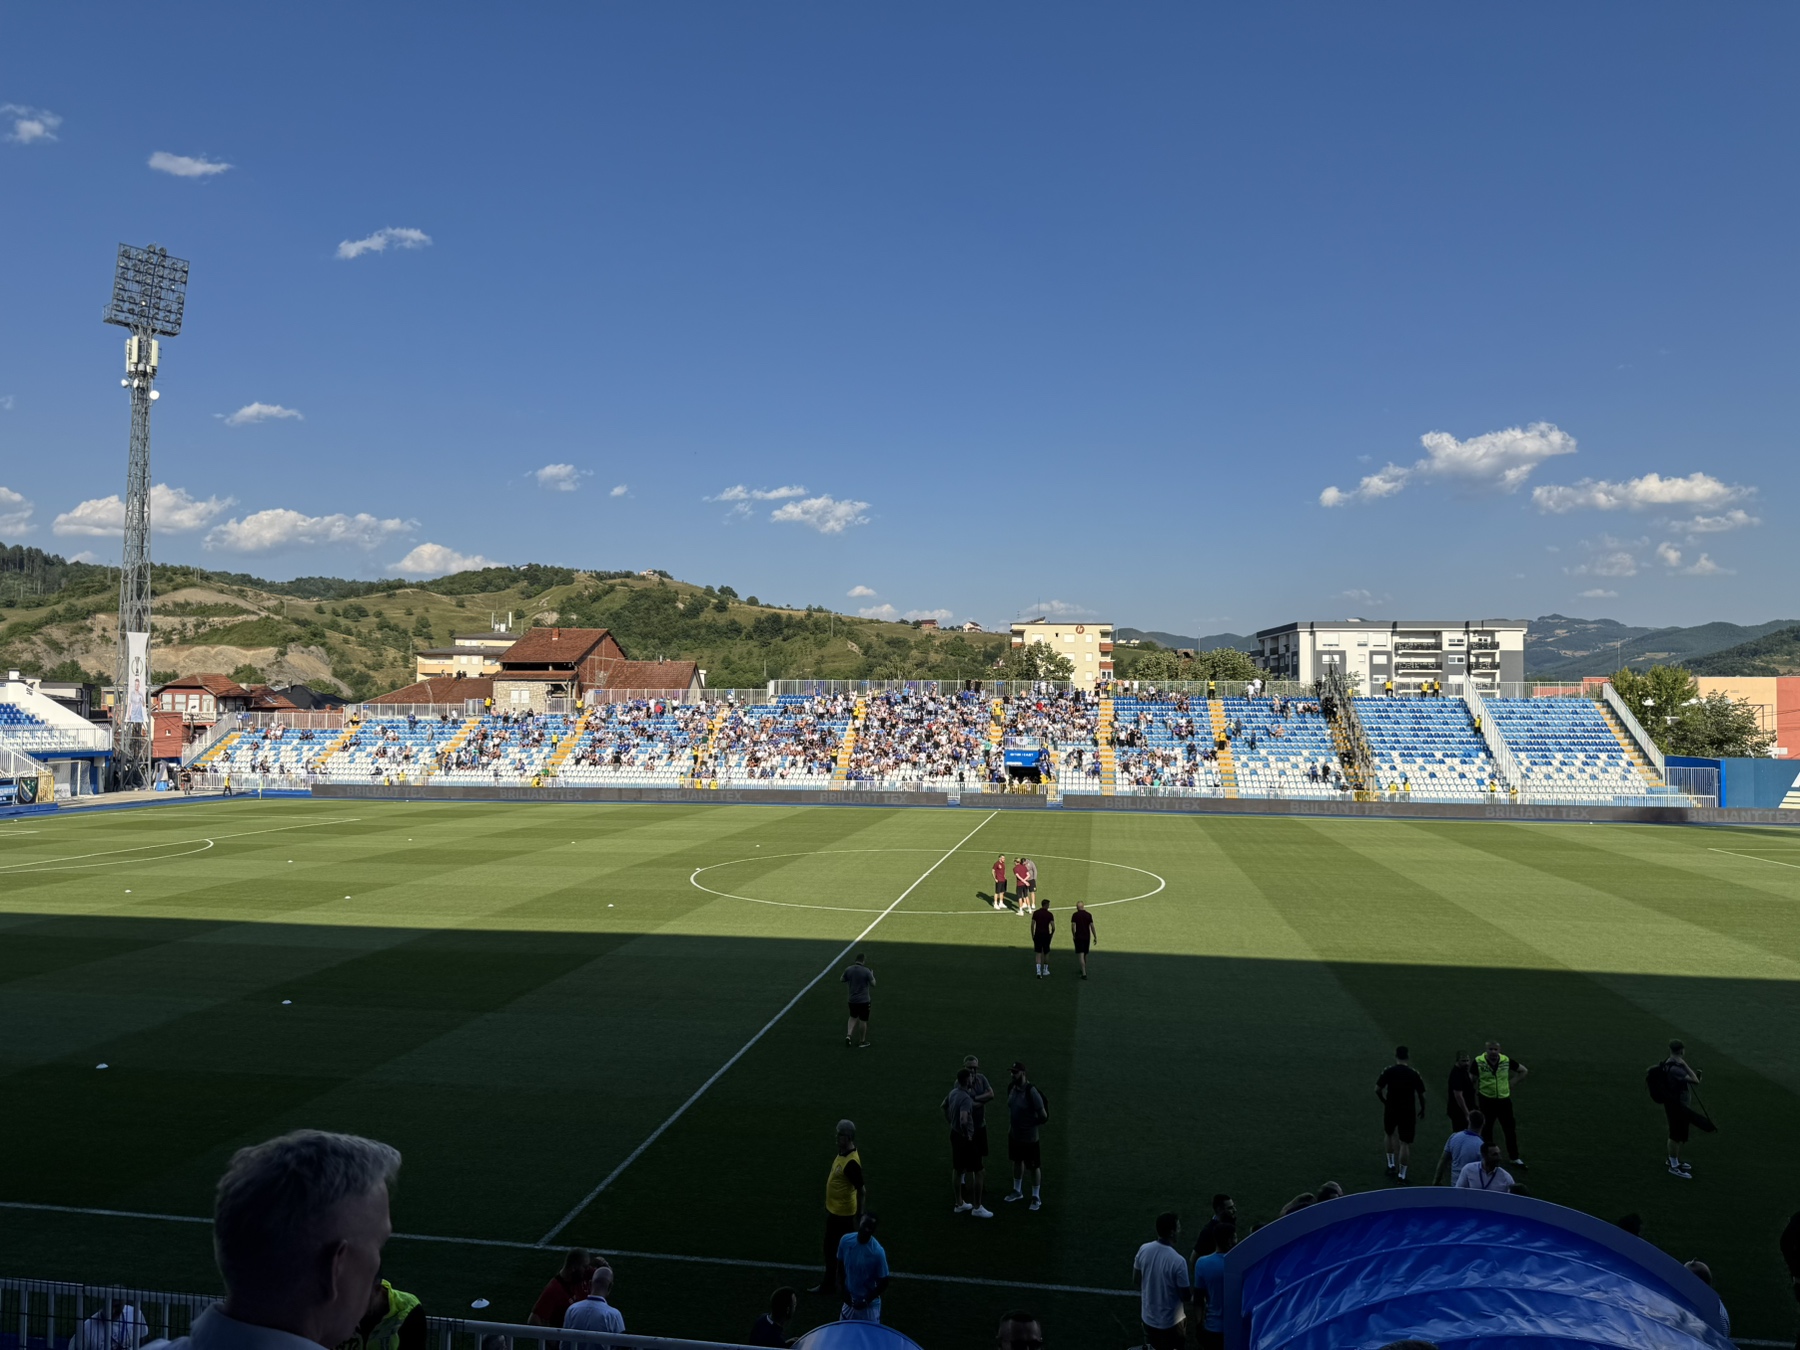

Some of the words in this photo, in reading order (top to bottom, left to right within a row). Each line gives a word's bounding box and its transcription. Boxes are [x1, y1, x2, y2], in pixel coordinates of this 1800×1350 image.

[347, 787, 399, 797] BRILIANT
[403, 788, 427, 798] TEX
[500, 788, 555, 799] BRILIANT
[556, 790, 582, 799] TEX
[719, 791, 742, 801] TEX
[820, 792, 880, 803] BRILIANT
[882, 793, 909, 803] TEX
[1105, 797, 1170, 809] BRILIANT
[1172, 799, 1200, 810] TEX
[1290, 801, 1360, 814] BRILIANT
[1363, 803, 1392, 815] TEX
[1485, 806, 1556, 818] BRILIANT
[1559, 808, 1590, 819] TEX
[1688, 809, 1761, 821] BRILIANT
[1765, 811, 1797, 822] TEX
